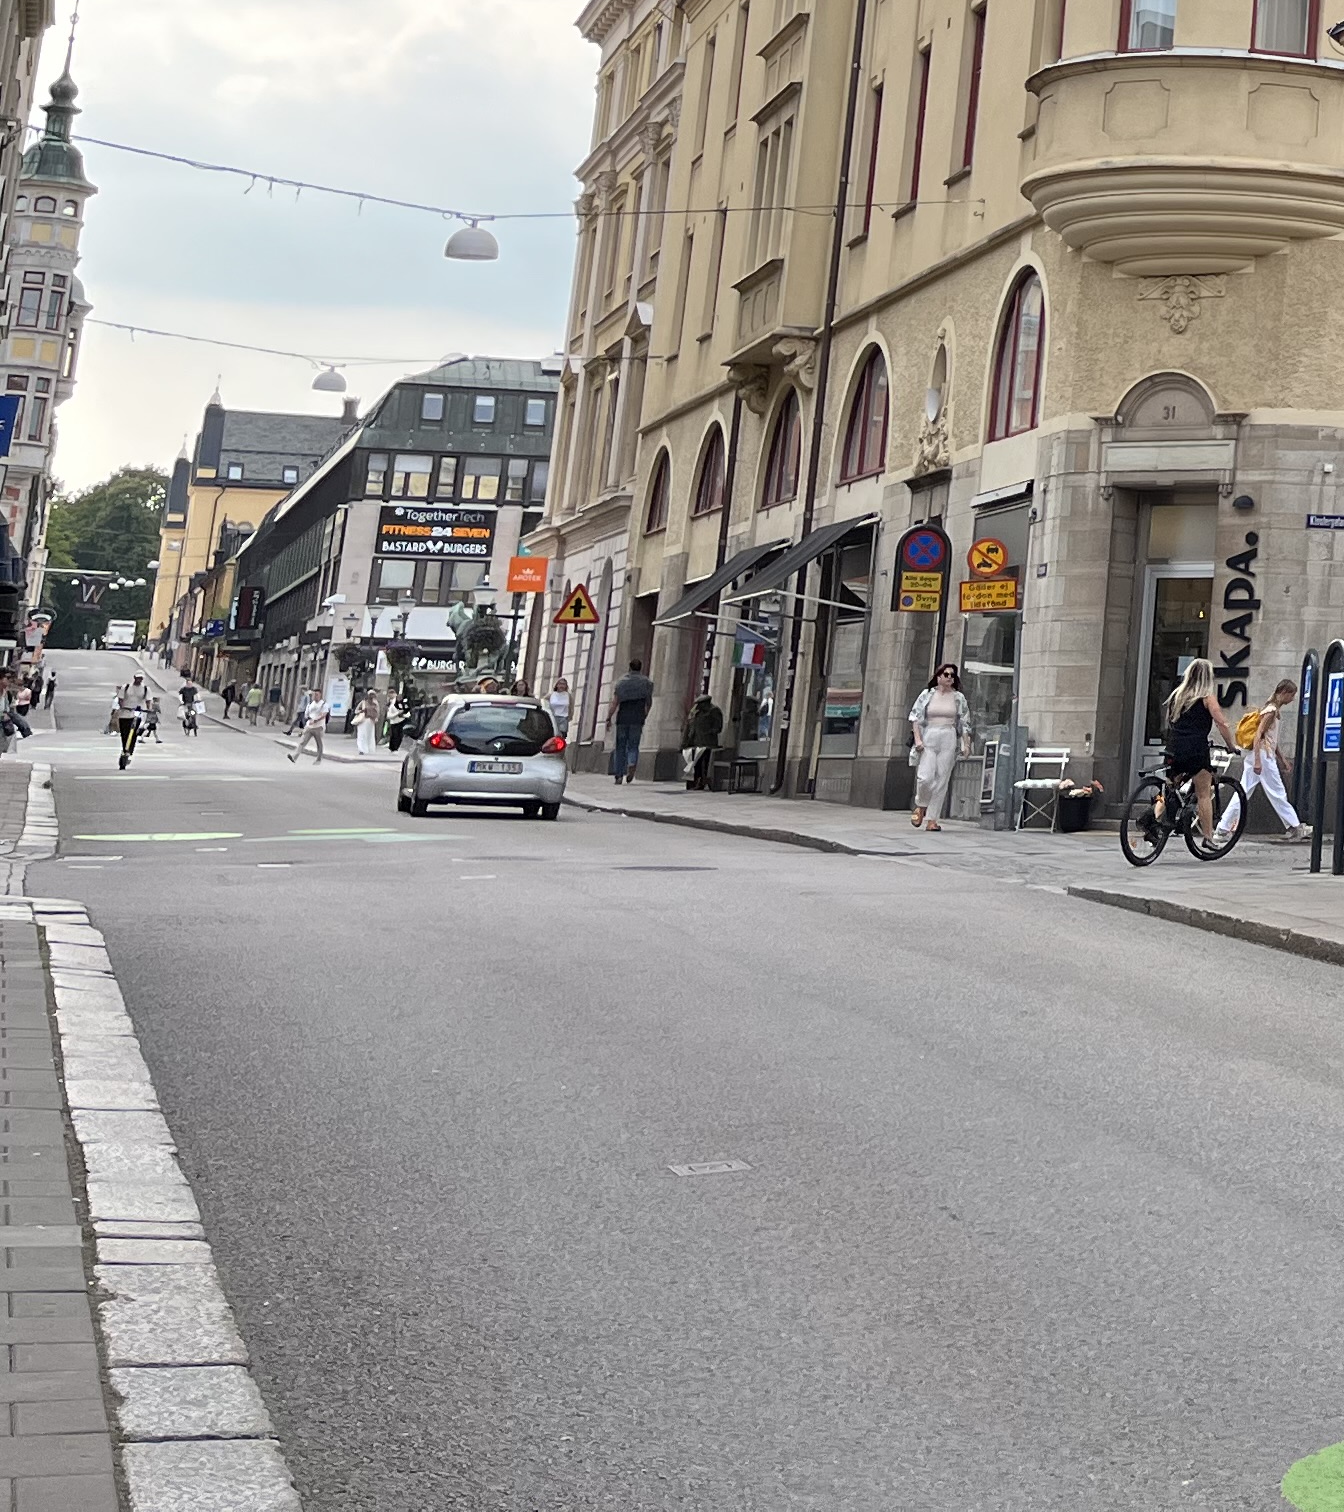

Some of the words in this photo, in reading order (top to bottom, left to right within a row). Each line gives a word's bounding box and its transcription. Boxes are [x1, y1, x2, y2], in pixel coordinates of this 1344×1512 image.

[1162, 406, 1176, 421] 31
[382, 541, 426, 553] BASTARD
[443, 543, 487, 555] BURGERS
[915, 593, 937, 604] Övrig
[996, 590, 1015, 598] med
